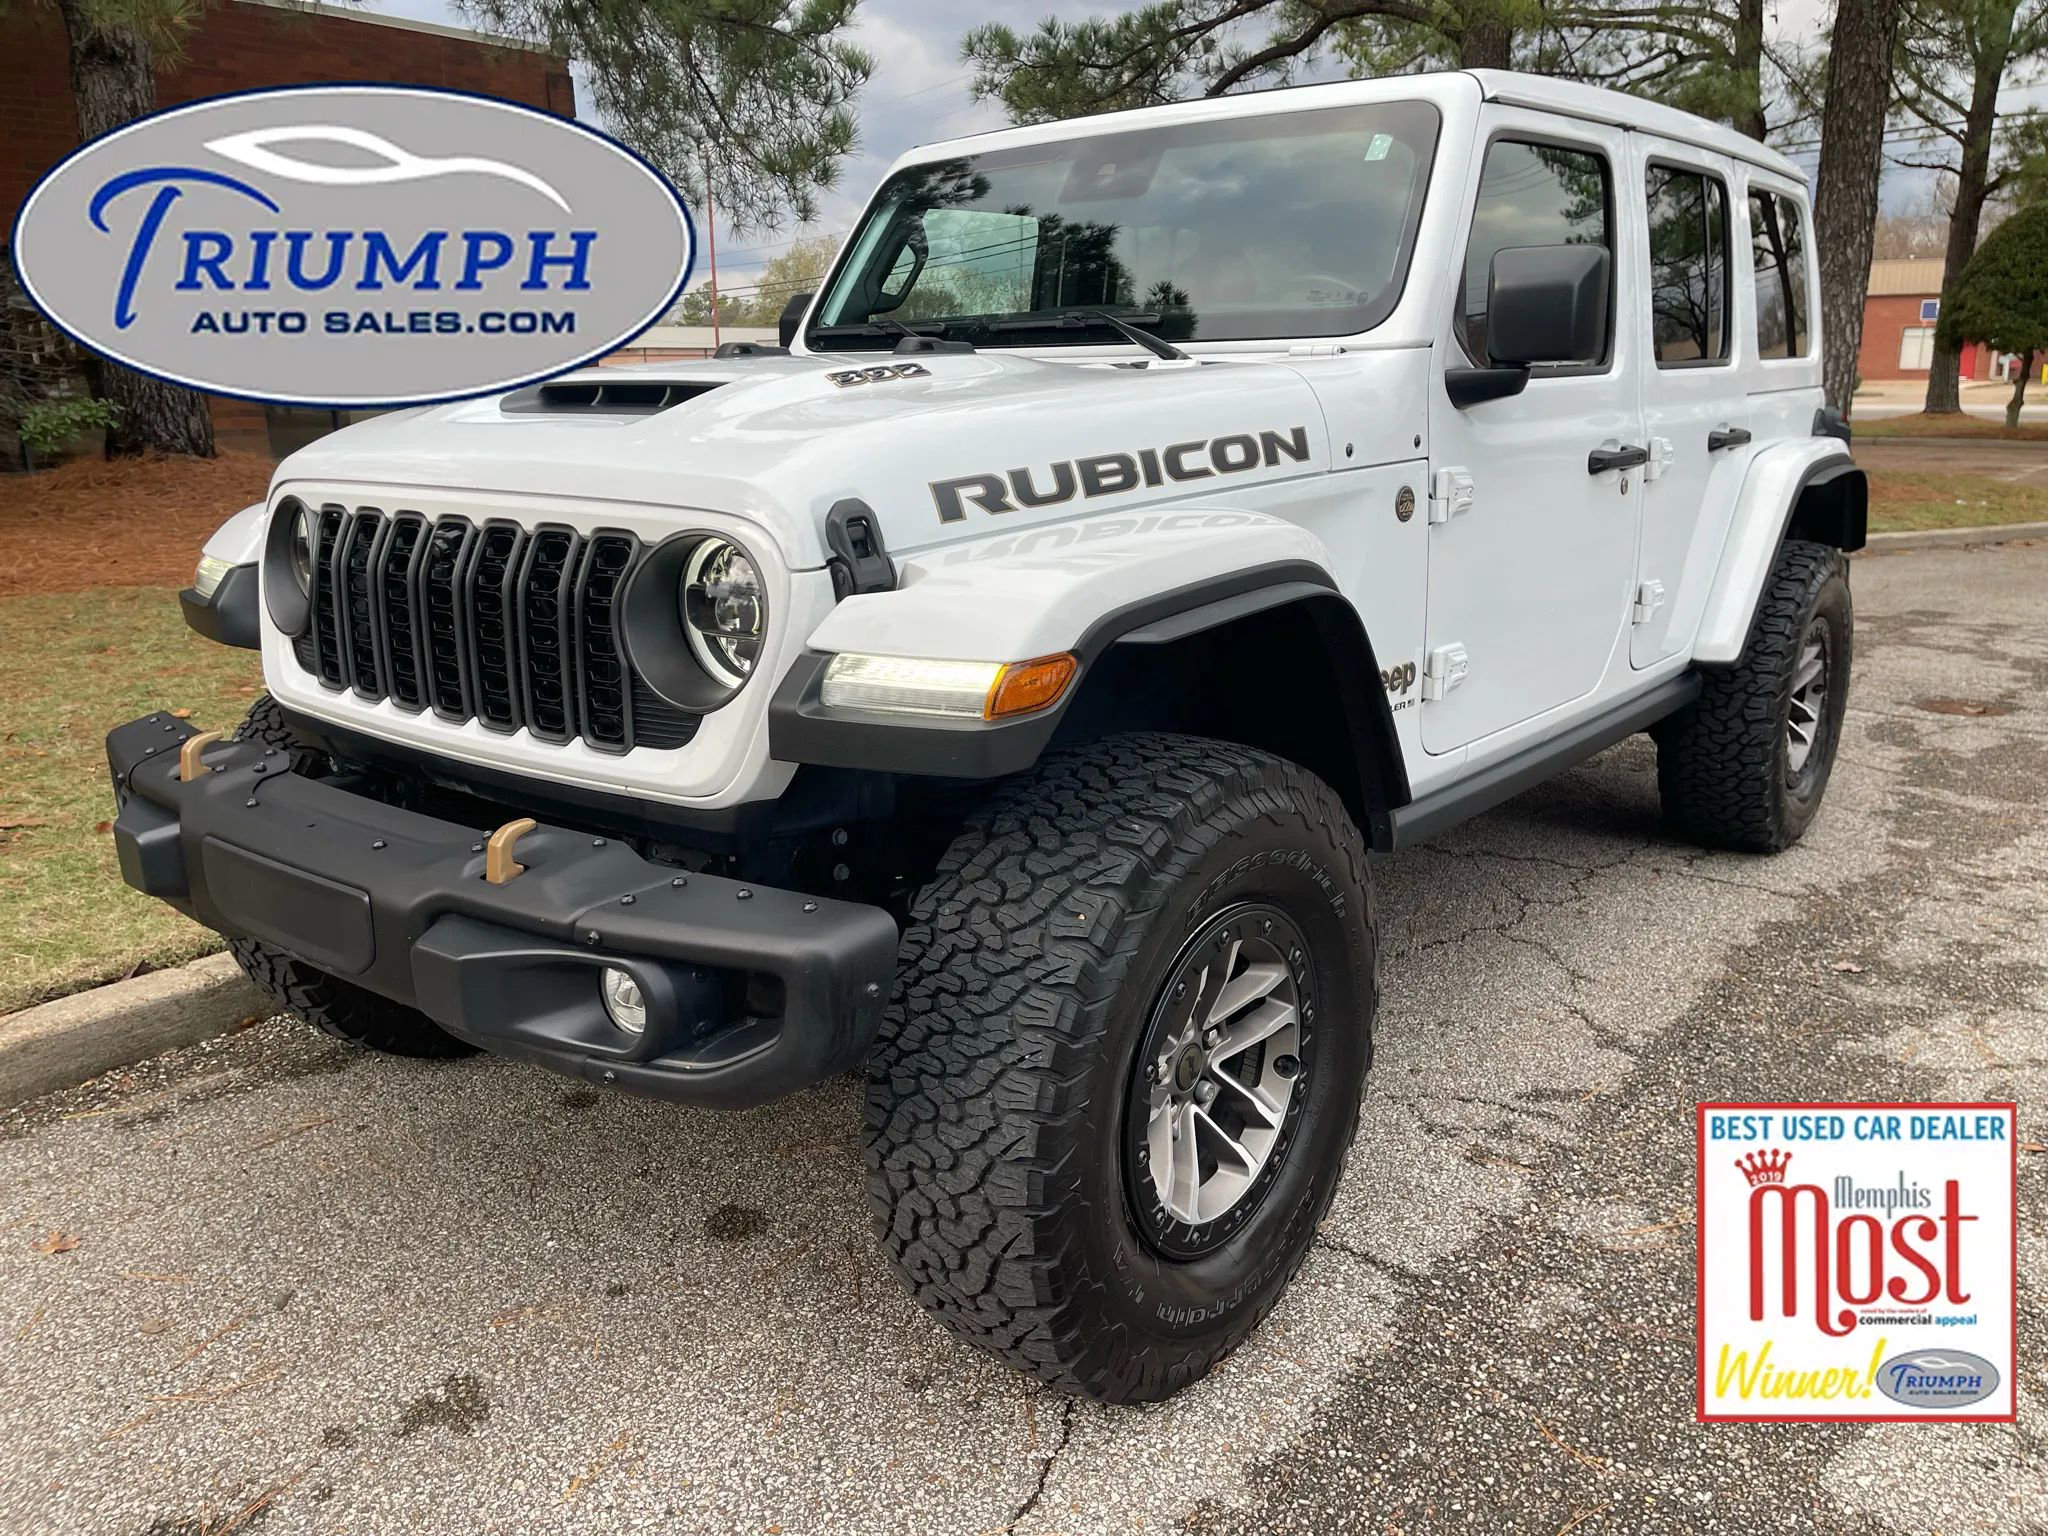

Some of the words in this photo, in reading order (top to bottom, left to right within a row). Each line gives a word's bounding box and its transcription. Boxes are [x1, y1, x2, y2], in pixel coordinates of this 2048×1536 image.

[824, 363, 932, 388] 392
[928, 425, 1310, 525] RUBICON
[1380, 661, 1416, 695] eep
